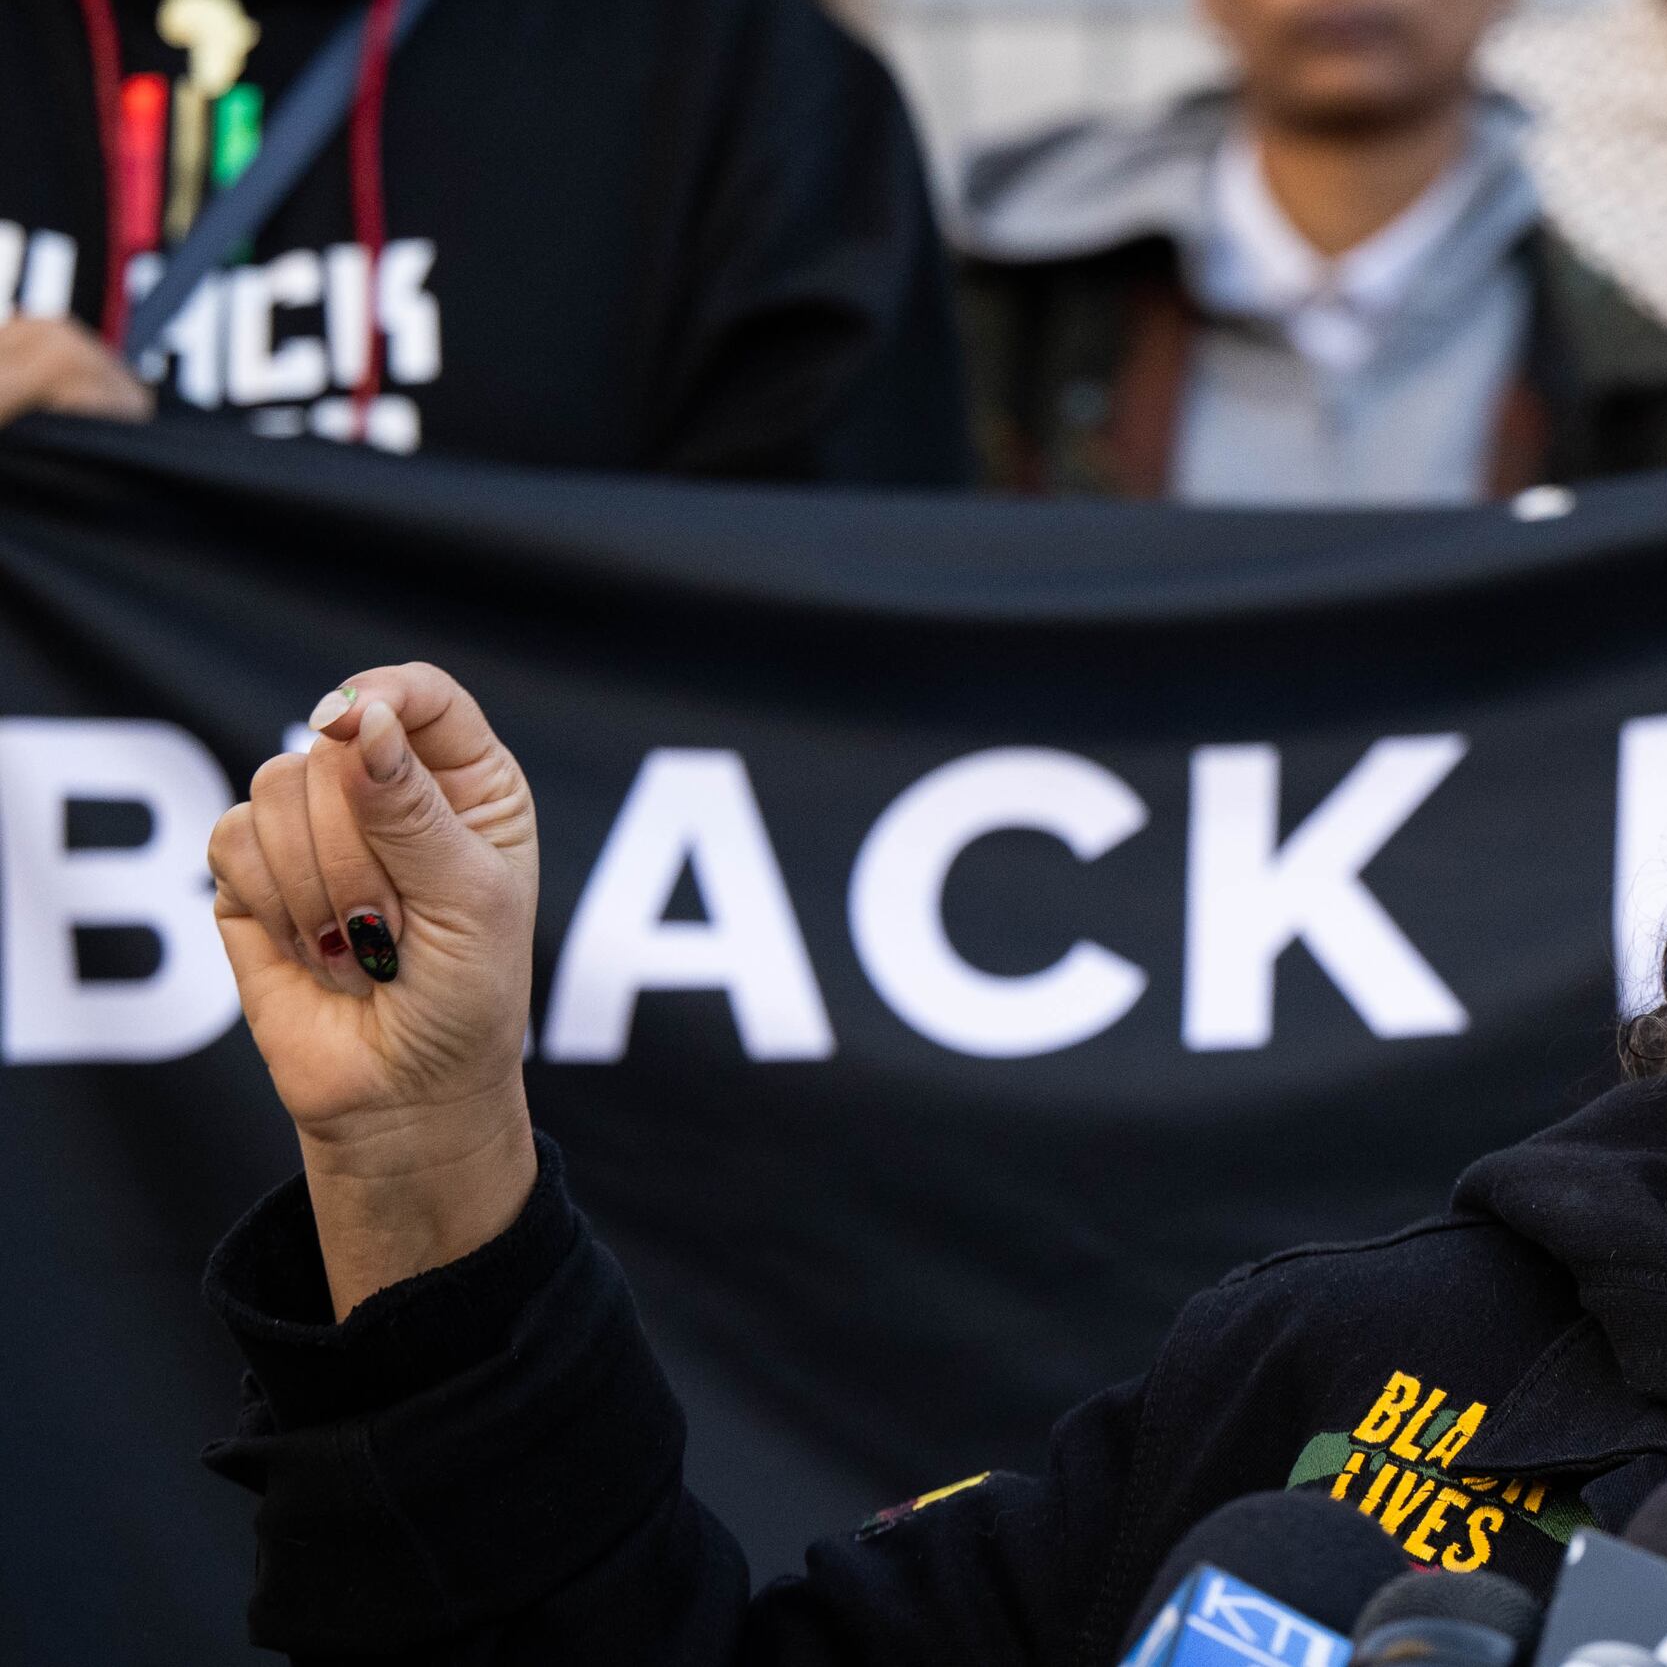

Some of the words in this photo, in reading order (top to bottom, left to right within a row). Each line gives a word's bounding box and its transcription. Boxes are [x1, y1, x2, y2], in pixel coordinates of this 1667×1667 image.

[0, 218, 444, 412] ACK
[0, 714, 1470, 1064] BACK
[1352, 1370, 1548, 1514] BLA
